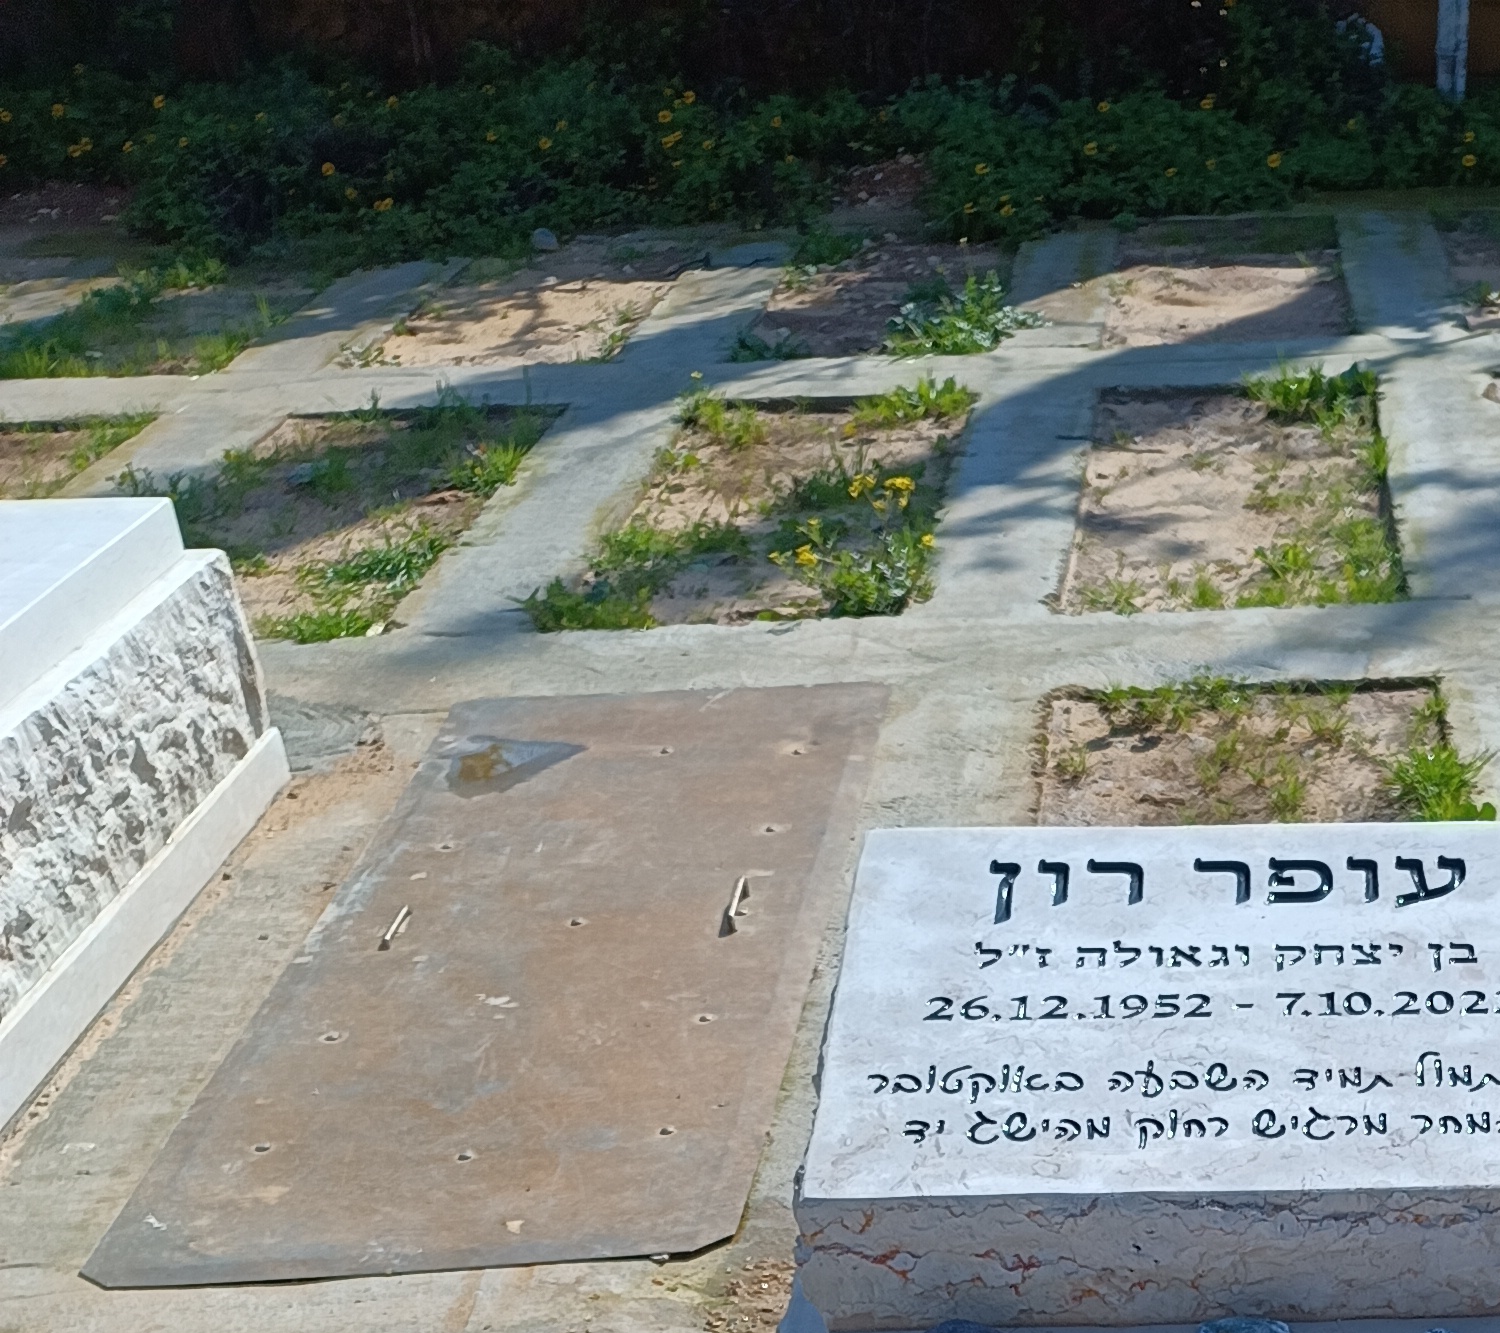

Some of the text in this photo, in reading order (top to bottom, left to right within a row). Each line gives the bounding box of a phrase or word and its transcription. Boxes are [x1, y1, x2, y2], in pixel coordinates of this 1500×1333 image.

[989, 854, 1467, 925] עופר רון
[1076, 939, 1250, 968] וגאולה
[1274, 942, 1404, 972] יצחק
[1427, 941, 1478, 971] בן
[922, 993, 1213, 1022] 26.12.1952
[867, 1063, 1085, 1105] באוקטובר
[1107, 1060, 1270, 1099] השבעה
[1292, 1066, 1394, 1094] תמיד
[902, 1119, 946, 1144] יד
[966, 1110, 1111, 1145] מהישג
[1134, 1108, 1229, 1150] רחוק
[1251, 1107, 1388, 1141] מרגיש
